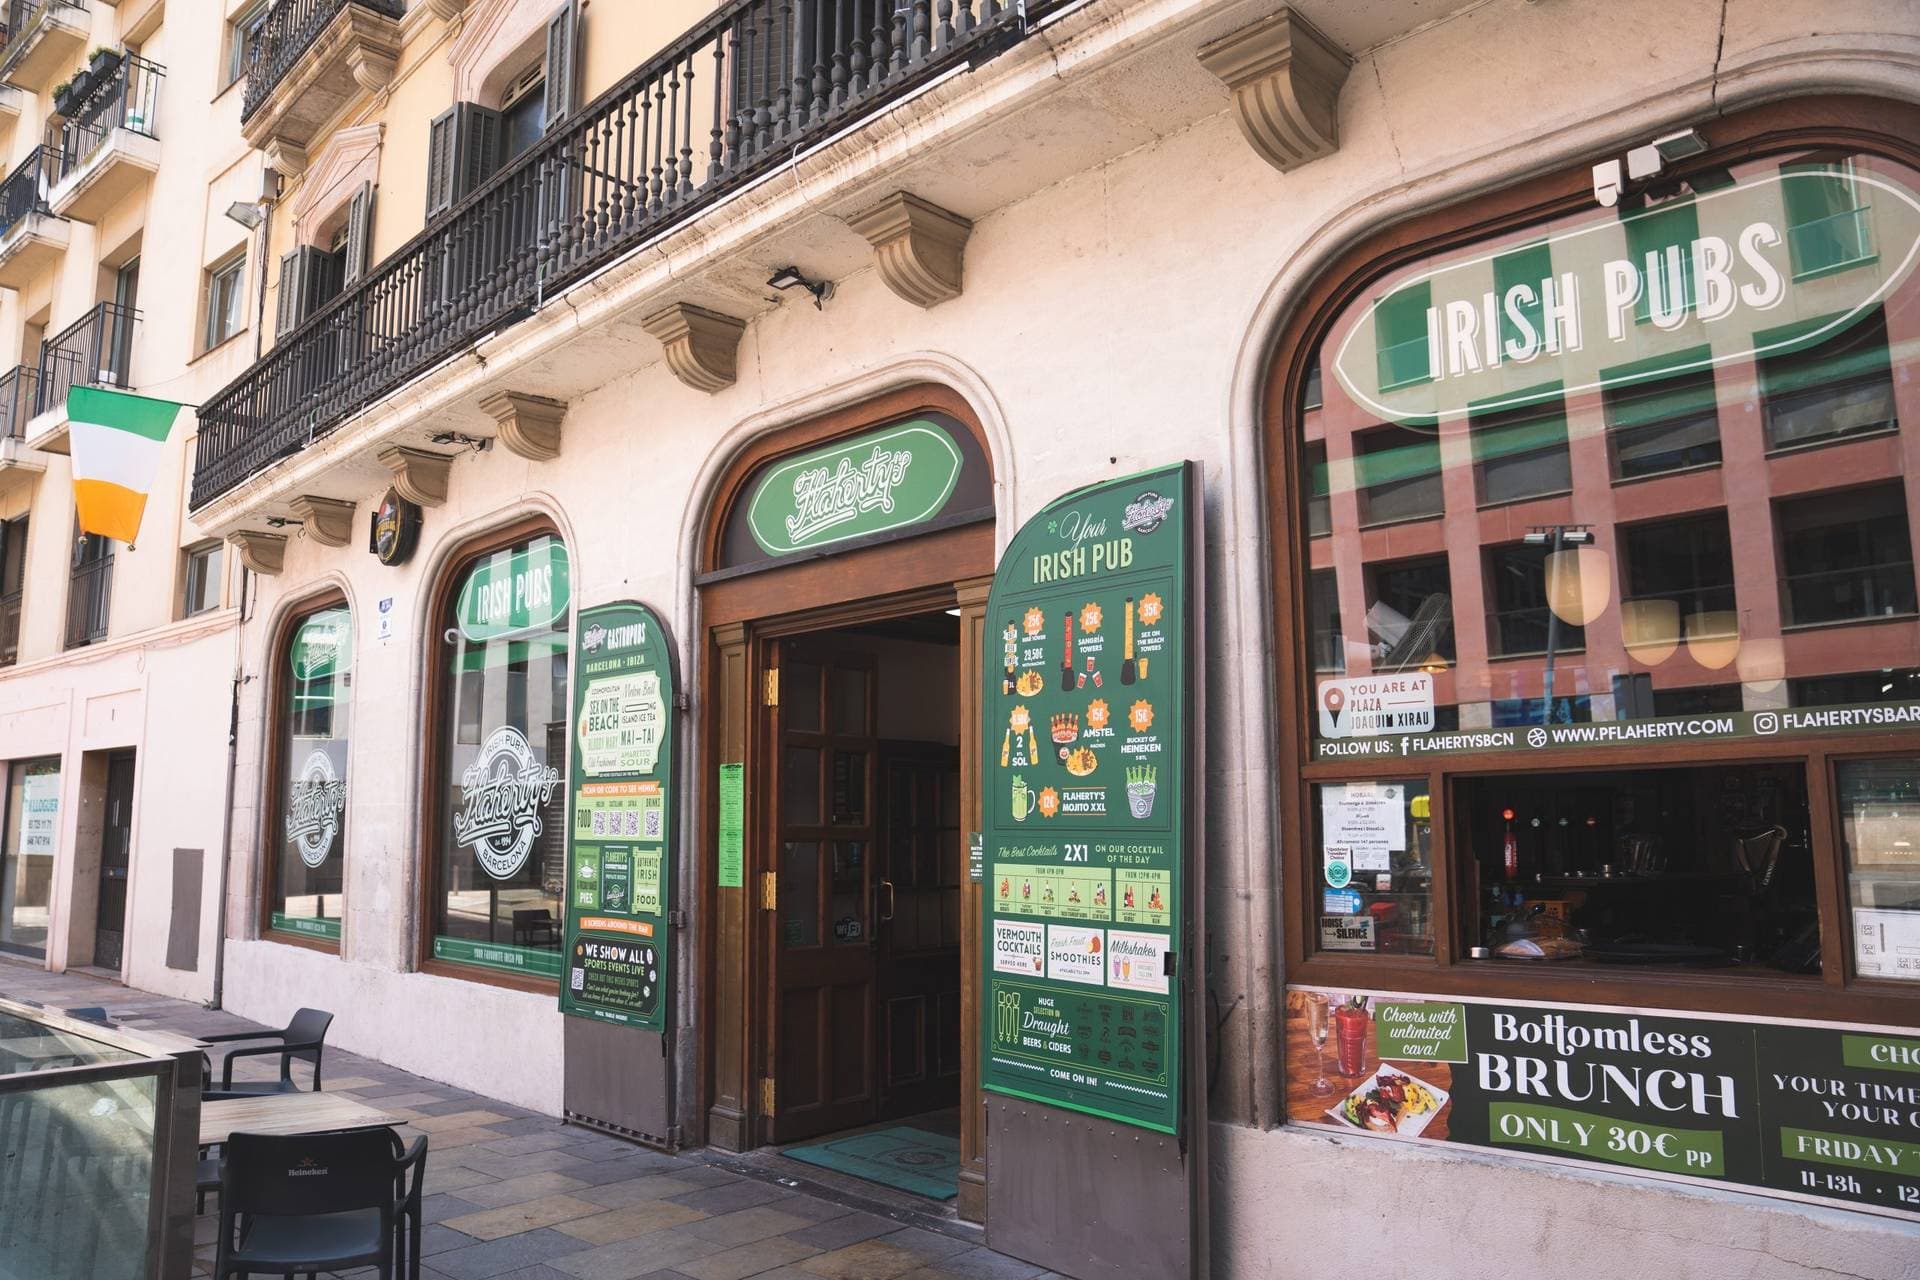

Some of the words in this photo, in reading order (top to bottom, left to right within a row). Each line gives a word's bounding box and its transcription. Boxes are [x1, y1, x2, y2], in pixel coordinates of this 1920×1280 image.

[1427, 272, 1583, 382] IRISH
[1603, 222, 1786, 342] PUBS
[1059, 510, 1108, 554] Your
[1033, 547, 1085, 584] IRISH
[1092, 537, 1133, 573] PUB
[477, 577, 512, 625] IRISH
[515, 564, 553, 614] PUBS
[607, 622, 646, 650] GASTROPUBS
[1079, 645, 1103, 653] TOWERS
[586, 658, 621, 674] BARCELONA
[626, 654, 645, 667] IBIZA
[1350, 684, 1377, 695] YOU
[1382, 681, 1406, 694] ARE
[1411, 679, 1426, 691] AT
[589, 699, 599, 715] SEX
[600, 698, 608, 714] ON
[609, 697, 620, 713] THE
[1350, 698, 1382, 712] PLAZA
[589, 714, 619, 732] BEACH
[622, 715, 638, 724] ISLAND
[647, 712, 656, 722] TEA
[1351, 714, 1394, 730] JOAQUIM
[1397, 711, 1429, 727] XIRAU
[1783, 705, 1920, 729] FLAHERTYSBAR
[1083, 727, 1115, 738] AMSTEL
[1551, 718, 1733, 743] WWW.PFLAHERTY.COM
[485, 736, 504, 759] IRISH
[505, 734, 525, 756] PUBS
[1016, 736, 1023, 748] 2
[1120, 743, 1162, 754] HEINEKEN
[1319, 740, 1372, 756] FOLLOW
[1374, 740, 1394, 753] US:
[1413, 732, 1514, 751] FLAHERTYSBCN
[620, 758, 651, 768] SOUR
[1011, 756, 1028, 767] SOL
[1062, 791, 1106, 801] FLAHERTY'S
[1062, 802, 1089, 812] MOJITO
[1090, 802, 1106, 812] XXL
[577, 808, 592, 828] FOOD
[482, 842, 526, 871] BARCELONA
[997, 847, 1010, 857] The
[1026, 844, 1058, 857] Cocktails
[1064, 844, 1089, 862] 2X1
[1108, 845, 1125, 854] OUR
[1127, 845, 1164, 855] COCKTAIL
[637, 857, 658, 869] AUTHENTIC
[1107, 855, 1117, 863] OF
[1119, 855, 1133, 864] THE
[1135, 856, 1150, 865] DAY
[637, 869, 657, 880] IRISH
[580, 892, 593, 904] PIES
[636, 895, 657, 905] FOOD
[1321, 918, 1343, 928] NOISE
[996, 927, 1042, 944] VERMOUTH
[1336, 928, 1368, 940] SILENCE
[585, 943, 598, 958] WE
[599, 945, 627, 961] SHOW
[628, 949, 645, 964] ALL
[997, 940, 1041, 956] COCKTAILS
[1109, 940, 1157, 958] Milkshakes
[584, 958, 607, 970] SPORTS
[608, 962, 630, 974] EVENTS
[631, 965, 645, 976] LIVE
[1050, 952, 1101, 966] SMOOTHIES
[1038, 997, 1054, 1007] HUGE
[1023, 1011, 1070, 1038] Draught
[1382, 1006, 1427, 1024] Cheers
[1428, 1010, 1458, 1026] with
[1390, 1024, 1453, 1042] unlimited
[1492, 1012, 1713, 1059] Bottomless
[1023, 1036, 1042, 1049] BEERS
[1048, 1042, 1072, 1054] CIDERS
[1402, 1041, 1440, 1058] cava!
[1050, 1068, 1070, 1081] COME
[1072, 1073, 1085, 1083] ON
[1086, 1076, 1098, 1086] IN!
[1474, 1052, 1741, 1119] BRUNCH
[1772, 1073, 1847, 1097] YOUR
[1822, 1100, 1901, 1126] YOUR
[1499, 1113, 1596, 1148] ONLY
[1607, 1126, 1680, 1159] 30€
[1797, 1135, 1903, 1166] FRIDAY
[288, 1167, 329, 1177] Heineken
[1800, 1170, 1862, 1195] 11-13h
